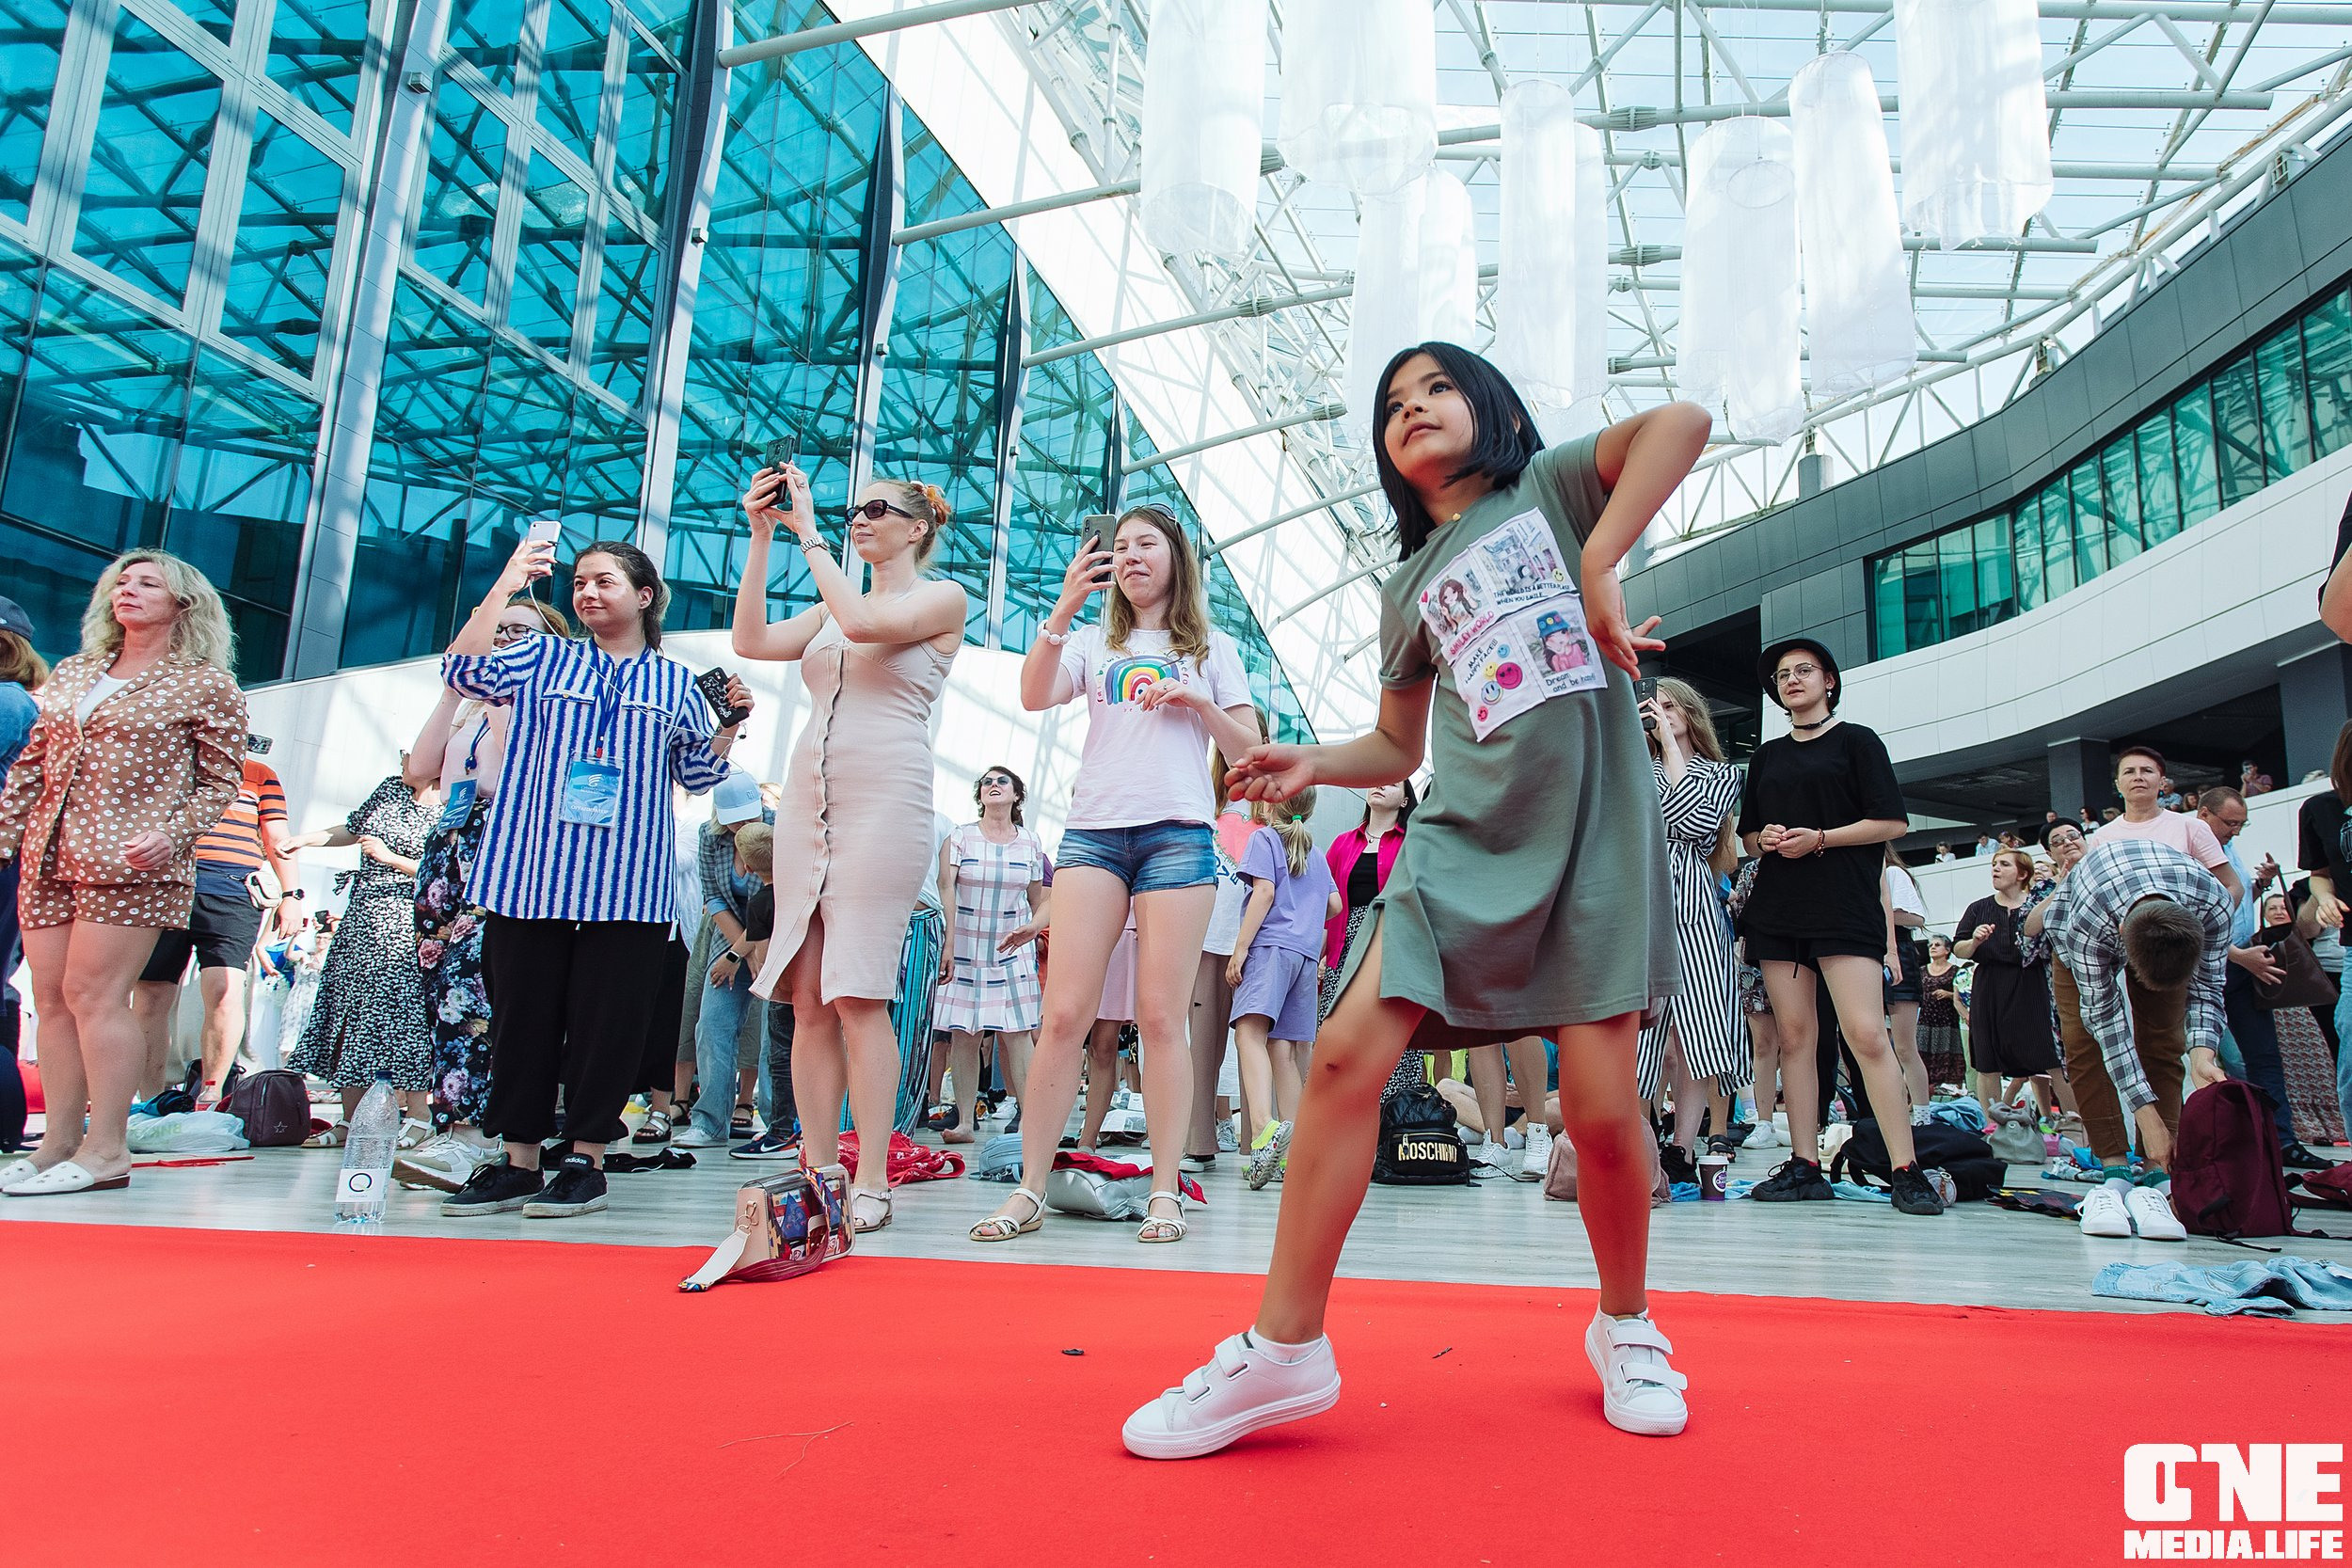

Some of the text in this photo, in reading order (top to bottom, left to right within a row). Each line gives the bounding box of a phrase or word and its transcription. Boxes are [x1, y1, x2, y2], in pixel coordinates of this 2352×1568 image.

[1450, 610, 1495, 656] SMILEY WORLD
[1468, 647, 1484, 669] MAKE
[1545, 672, 1570, 687] Dream
[1552, 681, 1567, 692] and
[564, 1156, 588, 1165] adidas
